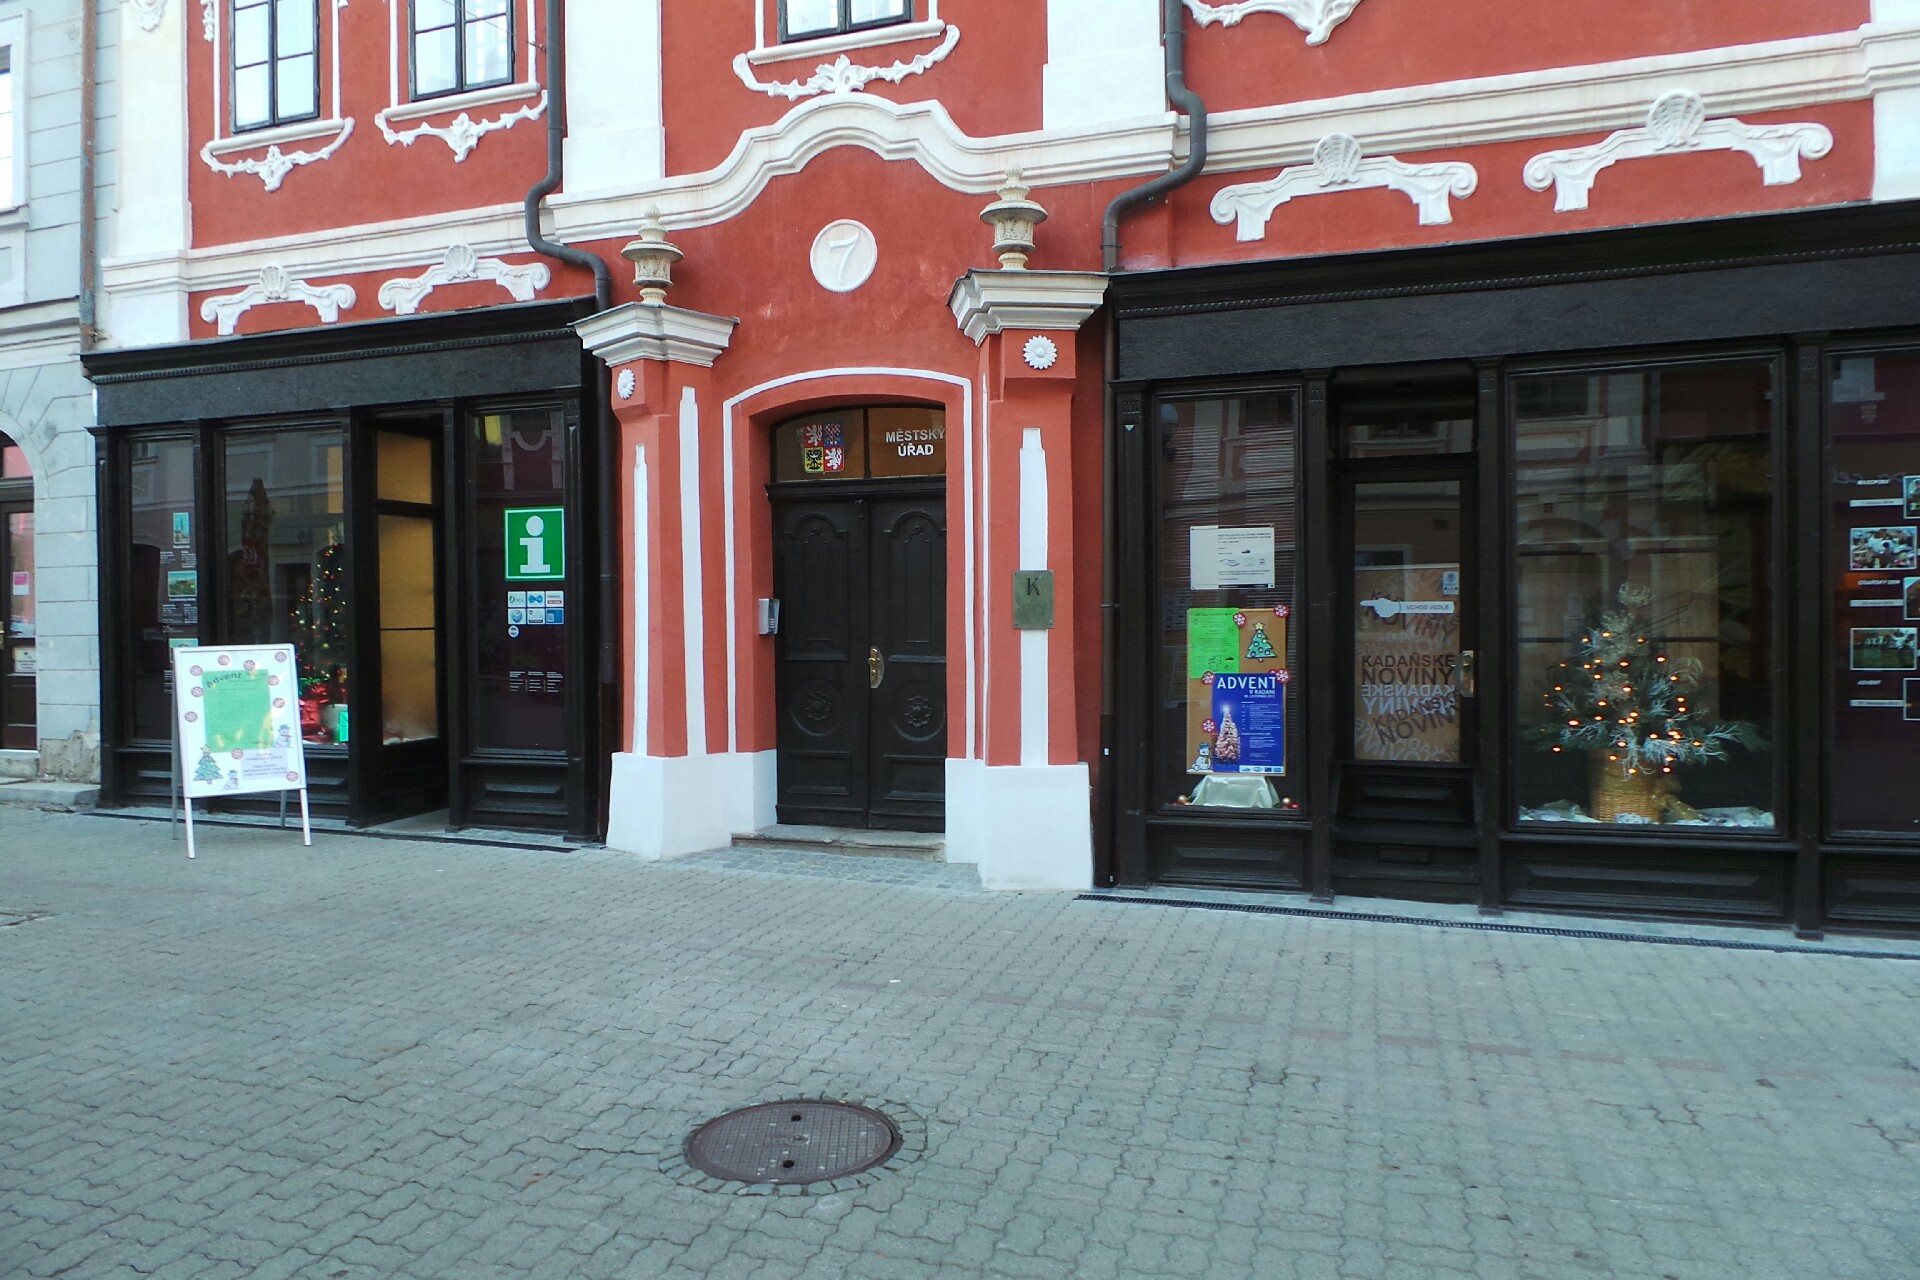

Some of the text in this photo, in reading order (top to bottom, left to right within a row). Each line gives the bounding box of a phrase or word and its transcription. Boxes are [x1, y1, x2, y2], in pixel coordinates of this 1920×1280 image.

[827, 230, 860, 283] 7
[885, 426, 946, 443] MĚSTSKÝ
[897, 442, 934, 457] ÚŘAD
[1026, 577, 1041, 596] K
[1361, 652, 1455, 668] KADAŇSKÉ
[1216, 676, 1276, 690] ADVENT
[1361, 668, 1454, 686] NOVINY
